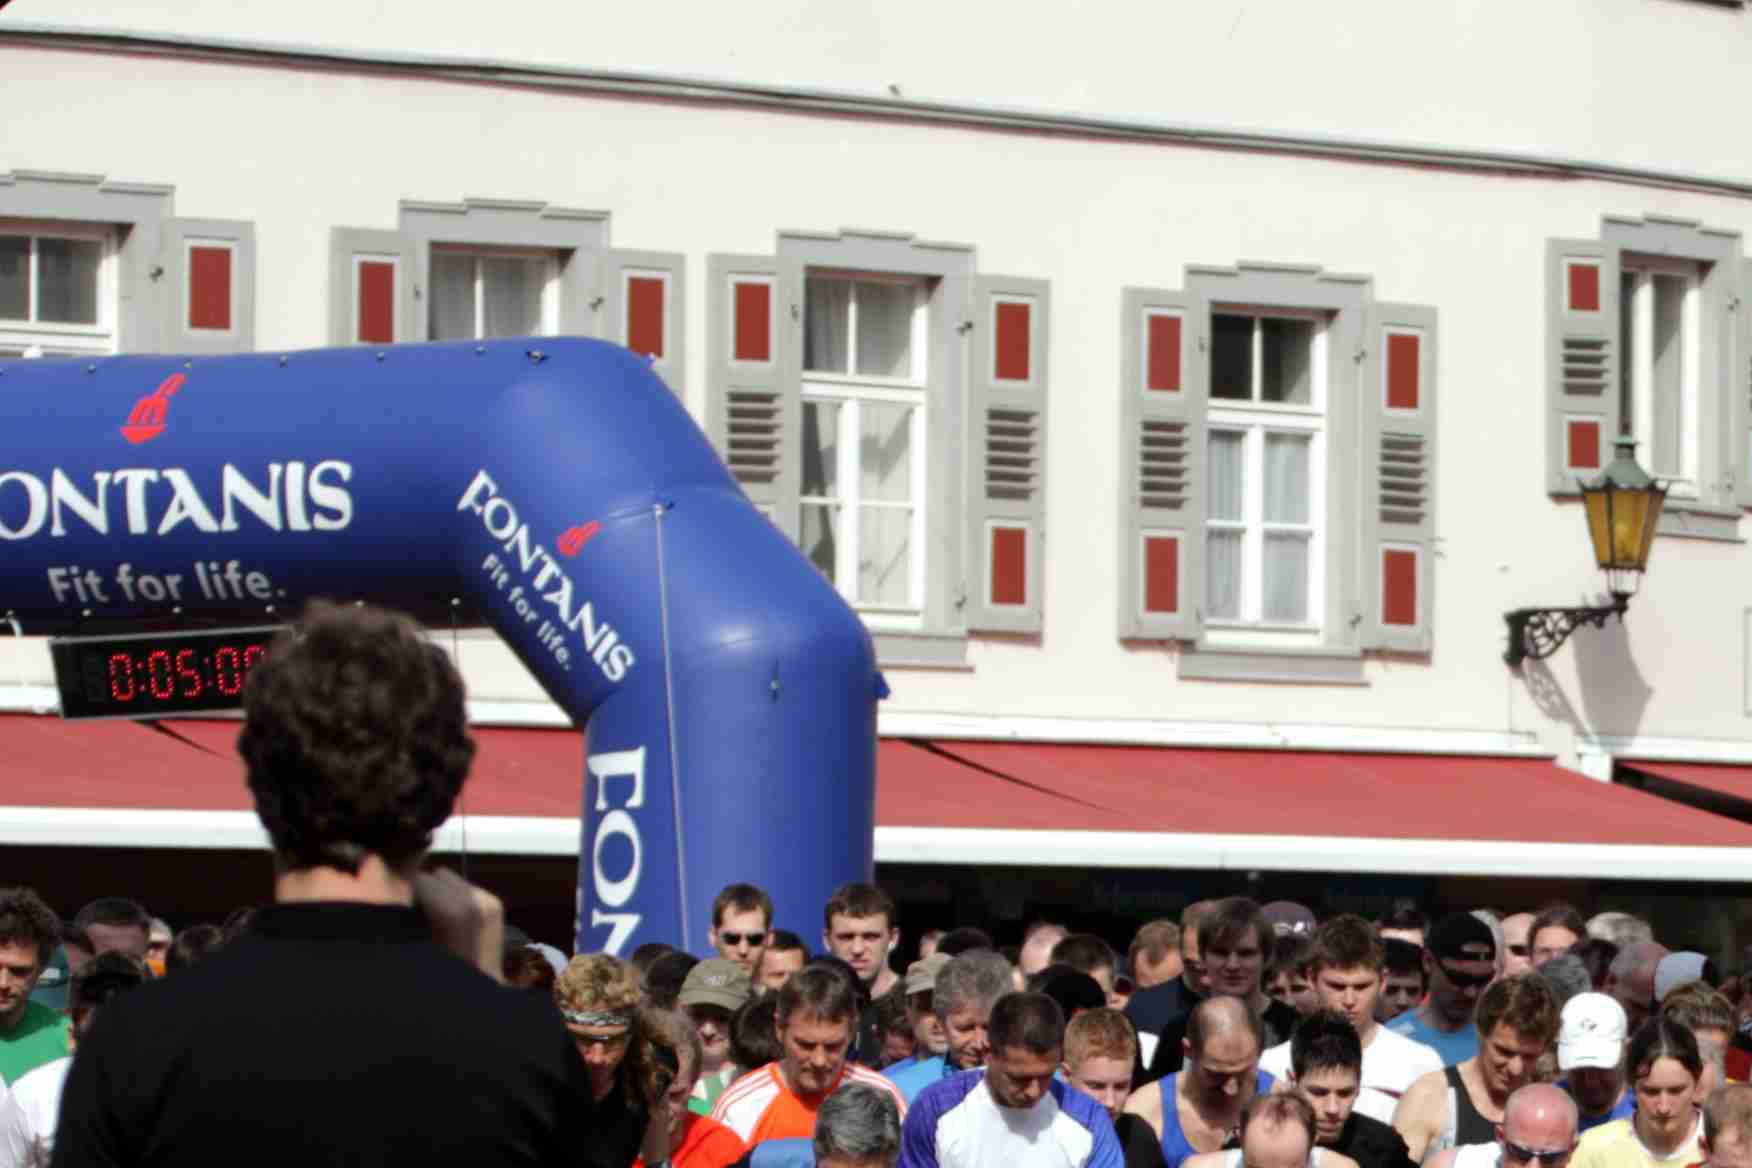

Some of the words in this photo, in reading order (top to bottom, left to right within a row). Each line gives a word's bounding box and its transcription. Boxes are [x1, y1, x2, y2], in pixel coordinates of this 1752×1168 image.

[0, 459, 354, 540] ONTANIS
[48, 565, 109, 603] Fit
[116, 562, 183, 600] for
[194, 560, 287, 600] life.
[456, 469, 635, 682] FONTANIS
[482, 553, 509, 590] Fit
[508, 585, 538, 623] for
